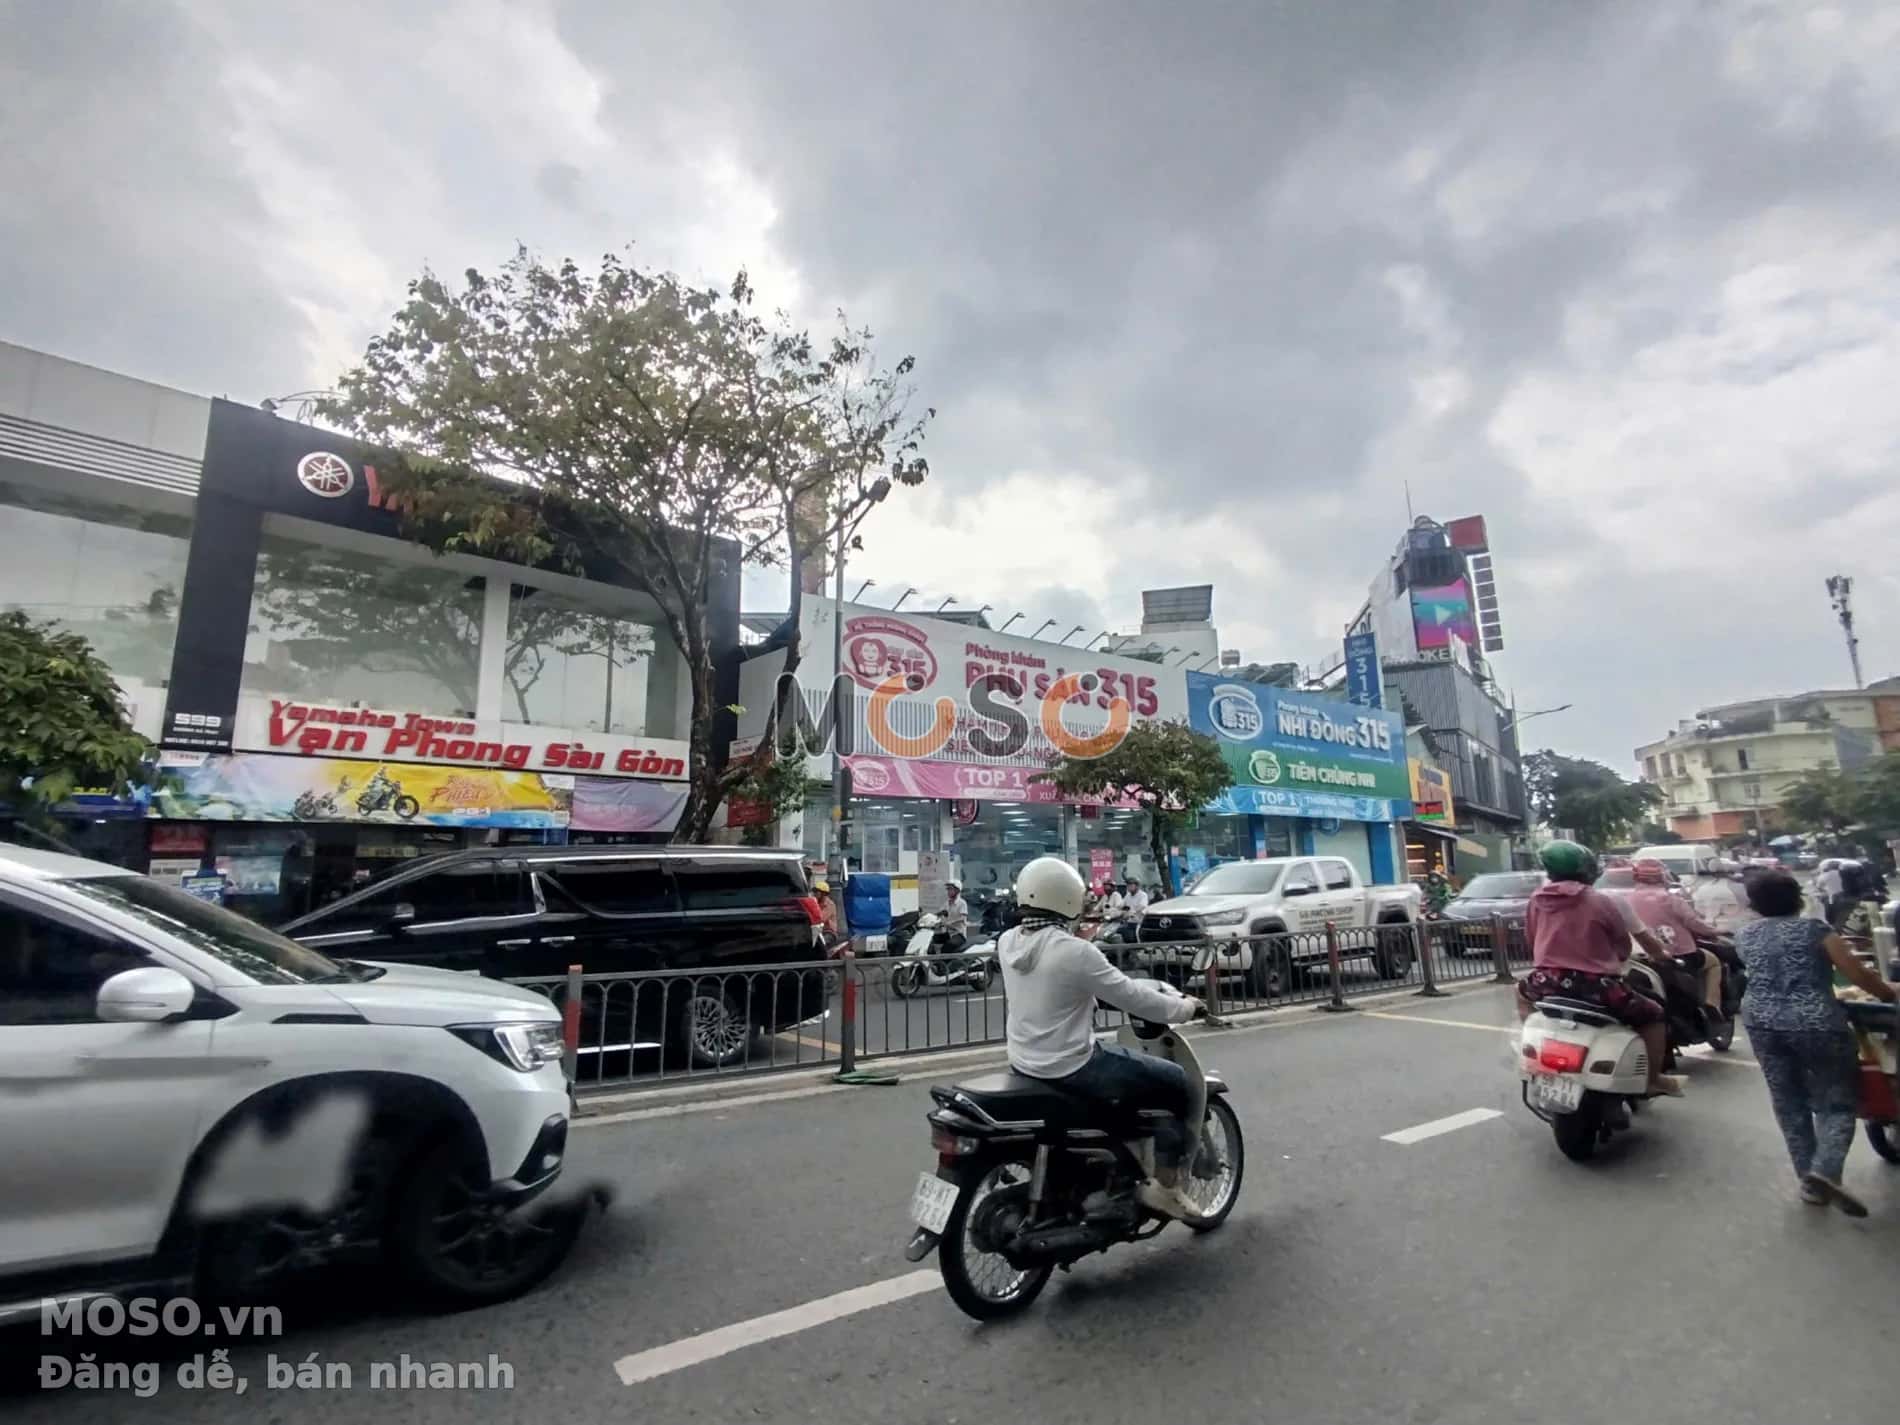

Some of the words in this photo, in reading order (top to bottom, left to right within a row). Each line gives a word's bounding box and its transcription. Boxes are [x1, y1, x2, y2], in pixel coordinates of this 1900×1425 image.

[1097, 668, 1159, 717] 315
[271, 700, 396, 729] Yamaha
[404, 713, 476, 735] Town
[1278, 712, 1308, 738] NHI
[1356, 716, 1392, 751] 315
[269, 716, 368, 757] Vạn
[383, 727, 533, 769] Phong
[543, 743, 605, 770] Sài
[616, 749, 685, 777] Gòn
[964, 768, 1007, 787] TOP
[1012, 771, 1024, 788] 1
[1258, 790, 1286, 805] TOP
